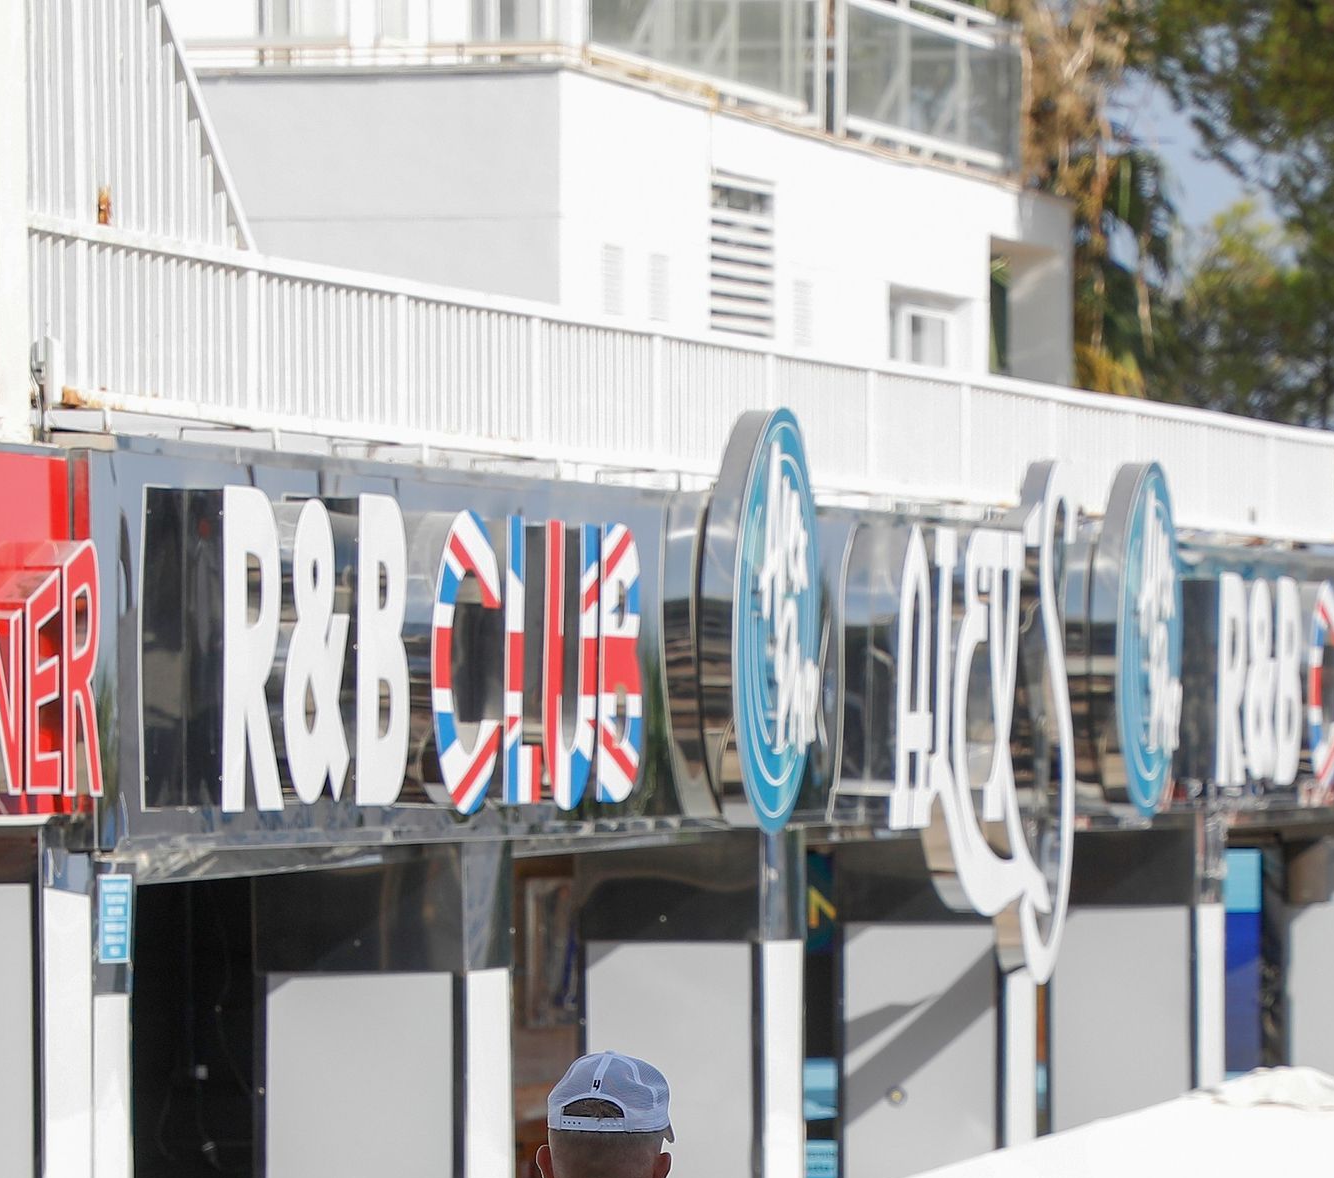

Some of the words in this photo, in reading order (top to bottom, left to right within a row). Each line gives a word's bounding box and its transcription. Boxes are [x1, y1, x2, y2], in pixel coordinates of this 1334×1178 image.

[221, 484, 410, 813] R&B
[430, 508, 642, 816] CLUB
[1215, 570, 1302, 787] R&B
